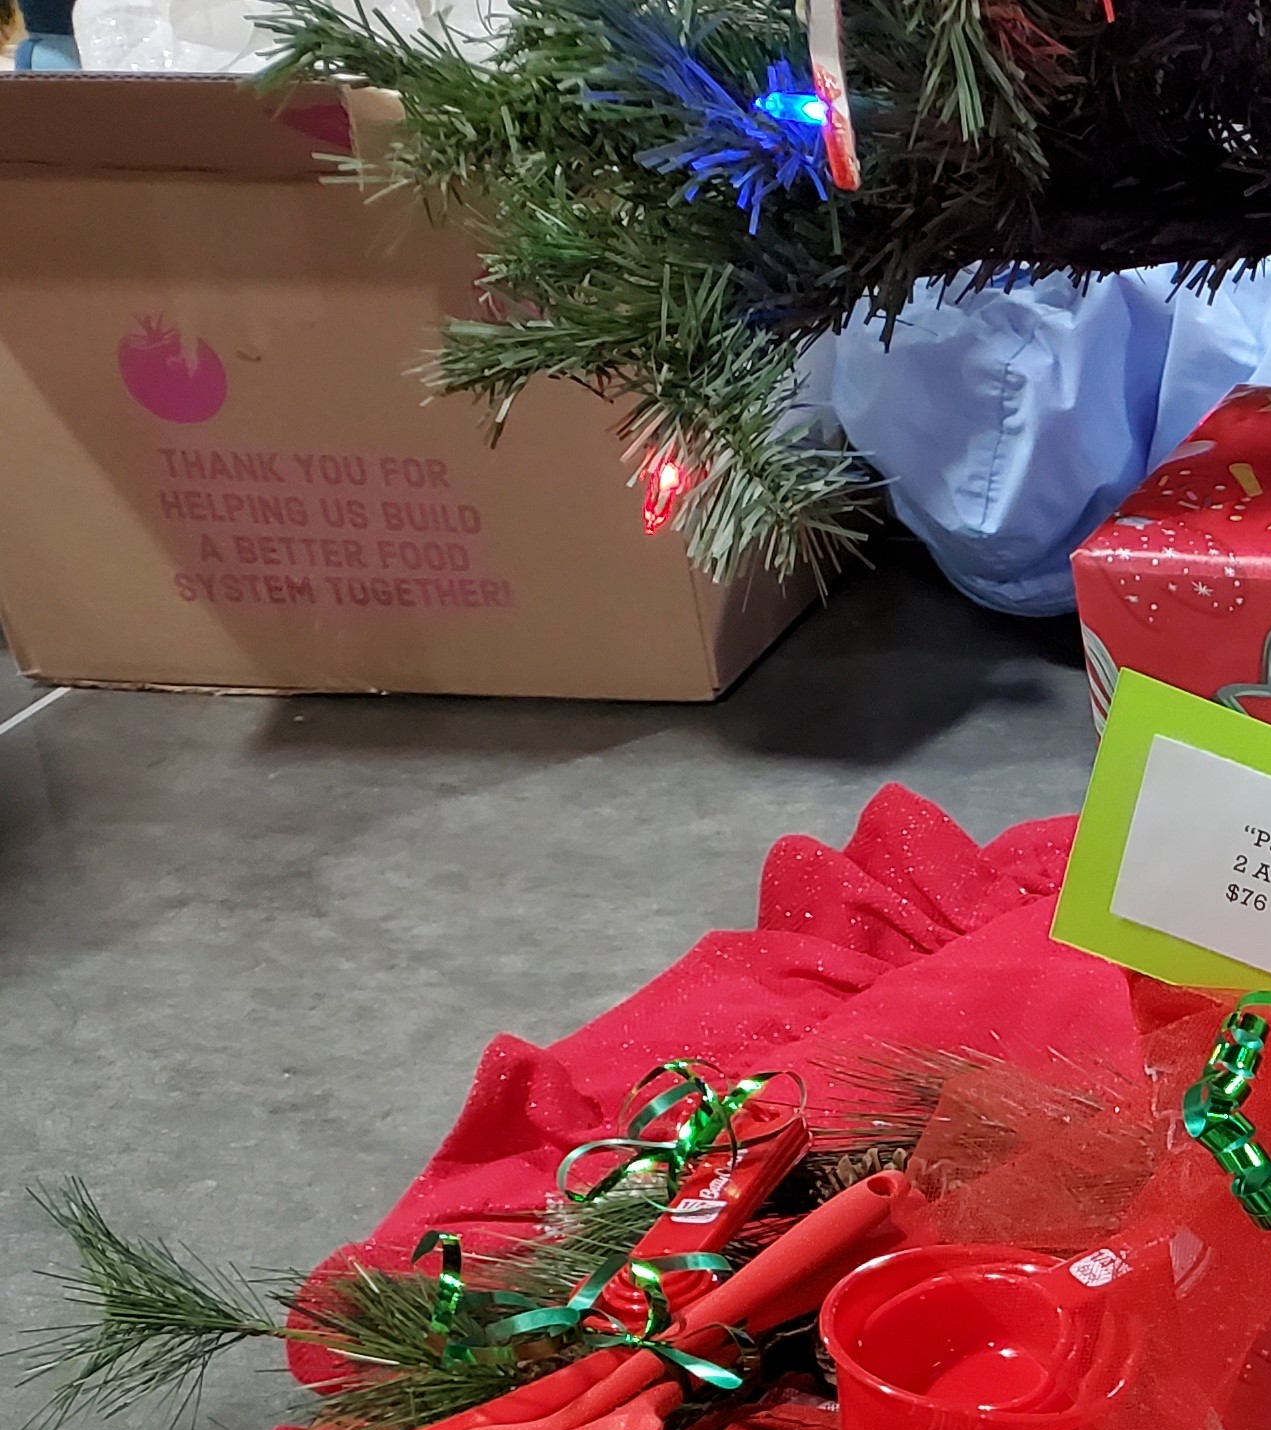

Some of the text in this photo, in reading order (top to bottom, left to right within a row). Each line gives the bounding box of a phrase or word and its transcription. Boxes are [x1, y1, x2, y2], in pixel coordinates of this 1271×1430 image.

[158, 448, 450, 488] THANK YOU FOR
[160, 489, 481, 535] HELPING US BUILD
[201, 532, 471, 572] A BETTER FOOD
[174, 573, 513, 609] SYSTEM TOGETHER!
[1232, 854, 1249, 875] 2
[1224, 882, 1269, 914] $76
